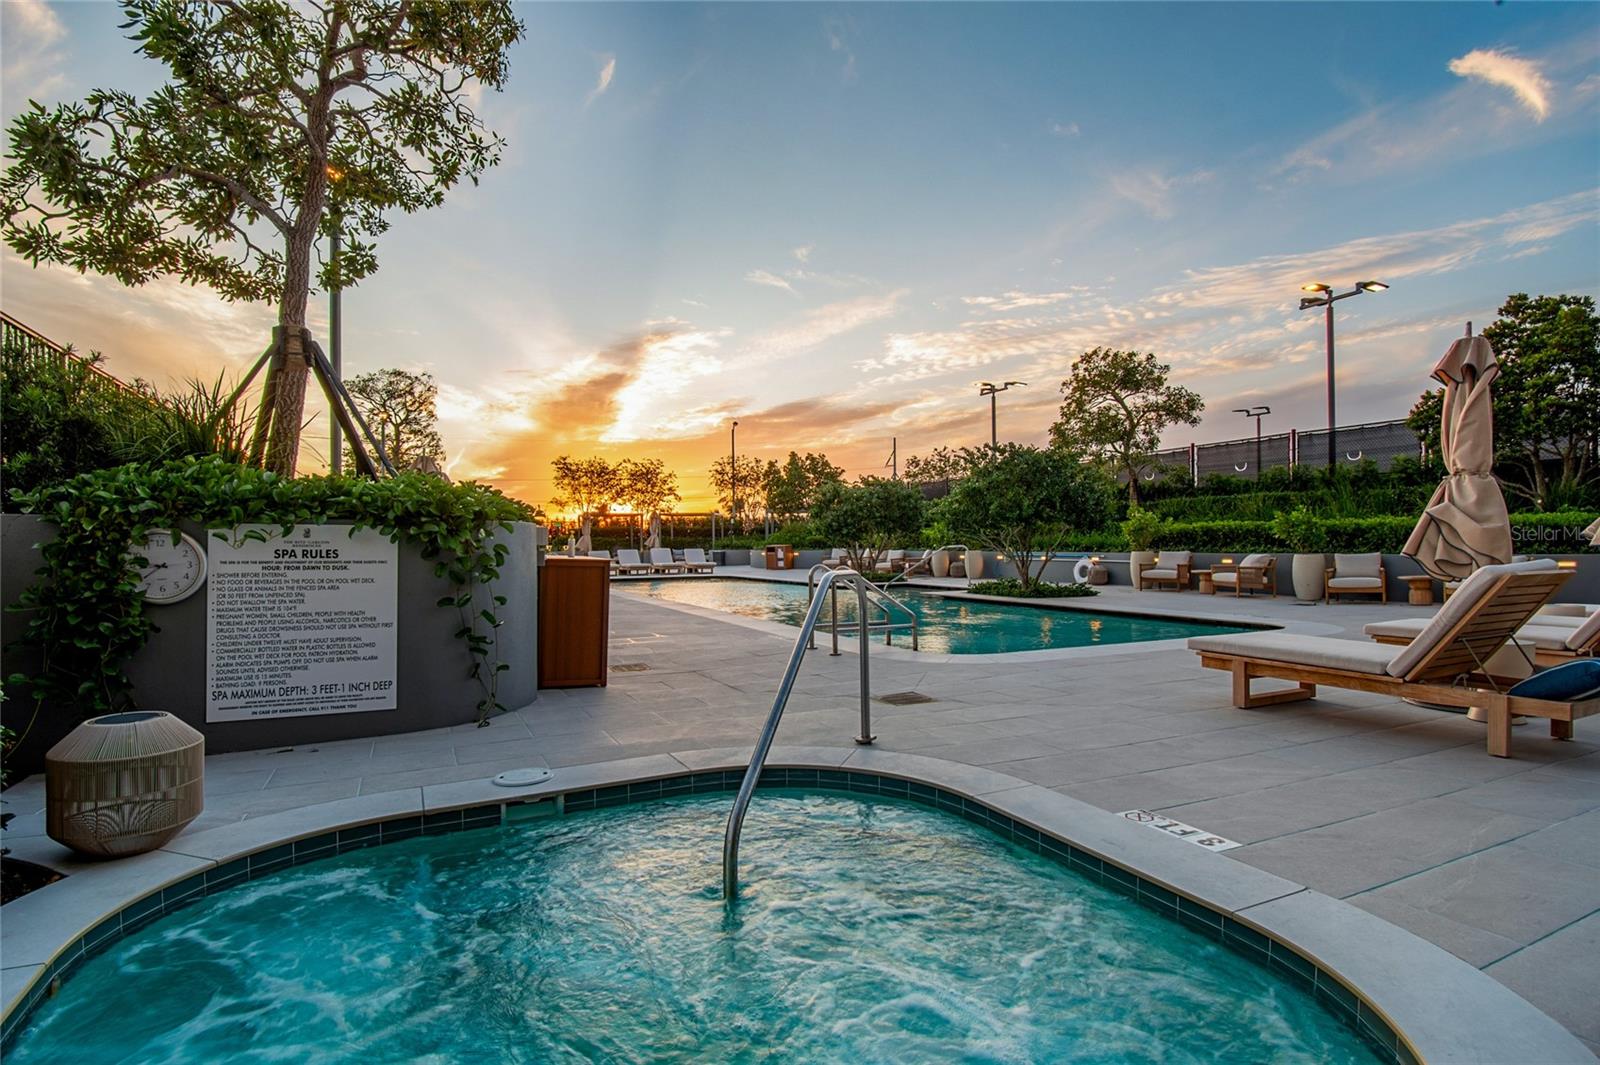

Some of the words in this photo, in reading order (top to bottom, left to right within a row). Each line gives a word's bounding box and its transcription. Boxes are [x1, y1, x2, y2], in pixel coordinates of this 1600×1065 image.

[274, 549, 297, 558] SPA
[302, 549, 339, 558] RULES
[212, 690, 228, 701] SPA
[231, 688, 276, 699] MAXIMUM
[279, 686, 308, 696] DEPTH:
[312, 685, 317, 694] 3
[349, 682, 370, 692] INCH
[373, 680, 392, 690] DEEP
[1197, 837, 1226, 846] 3
